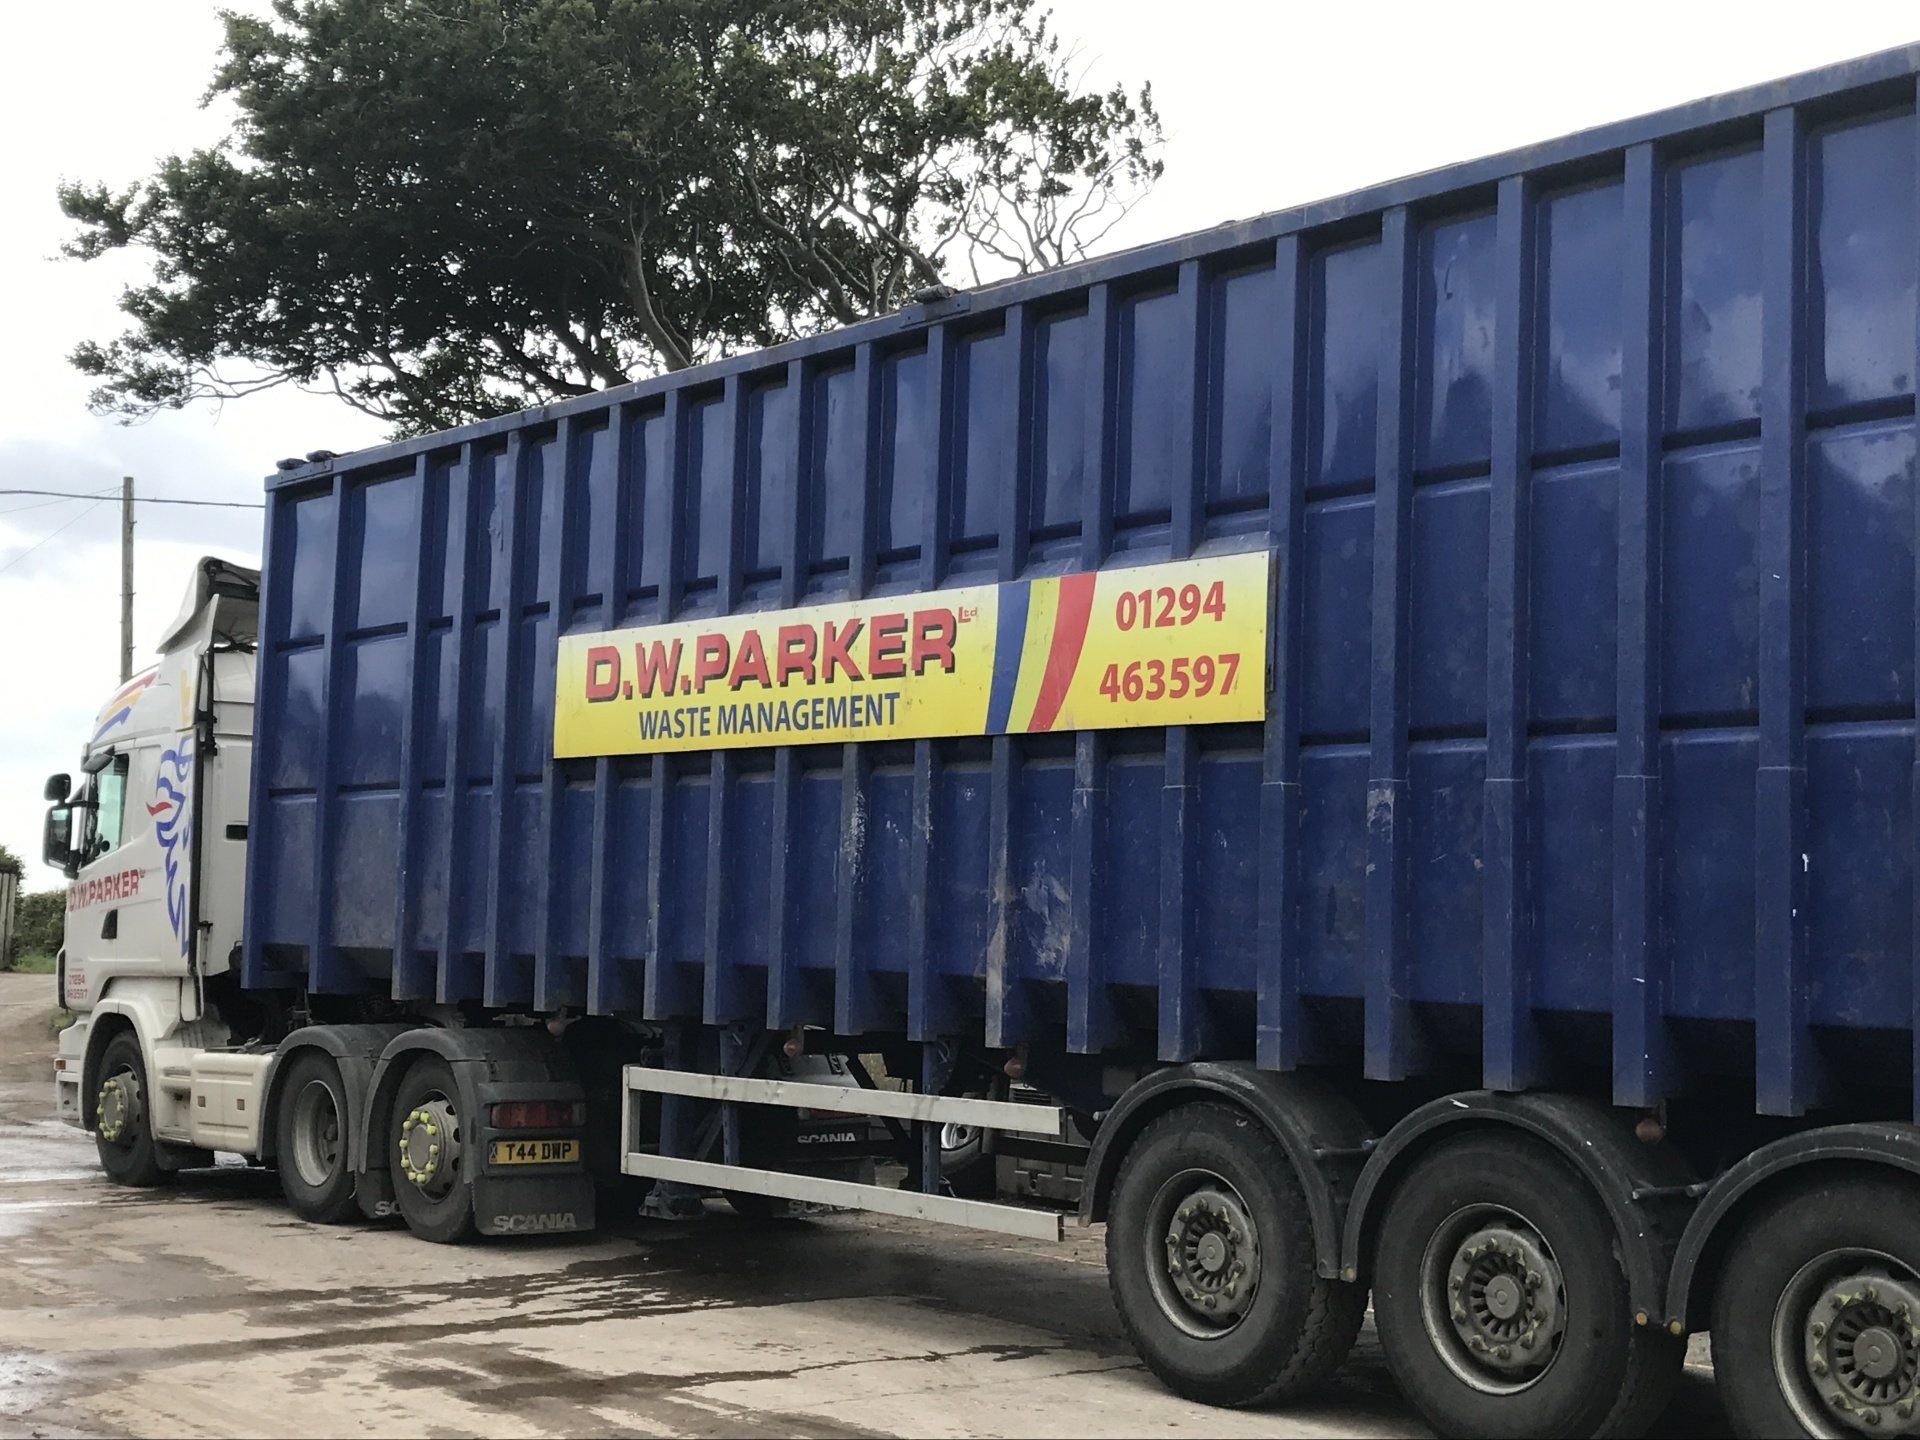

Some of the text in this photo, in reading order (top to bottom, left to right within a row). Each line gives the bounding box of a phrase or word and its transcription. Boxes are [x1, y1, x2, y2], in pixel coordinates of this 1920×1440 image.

[1115, 580, 1226, 632] 01294
[585, 606, 978, 703] D.W.PARKER Ltd
[1098, 653, 1241, 703] 463597
[638, 692, 901, 741] WASTE MANAGEMENT
[506, 1142, 572, 1161] T44 DWP
[493, 1212, 577, 1232] SCANIA
